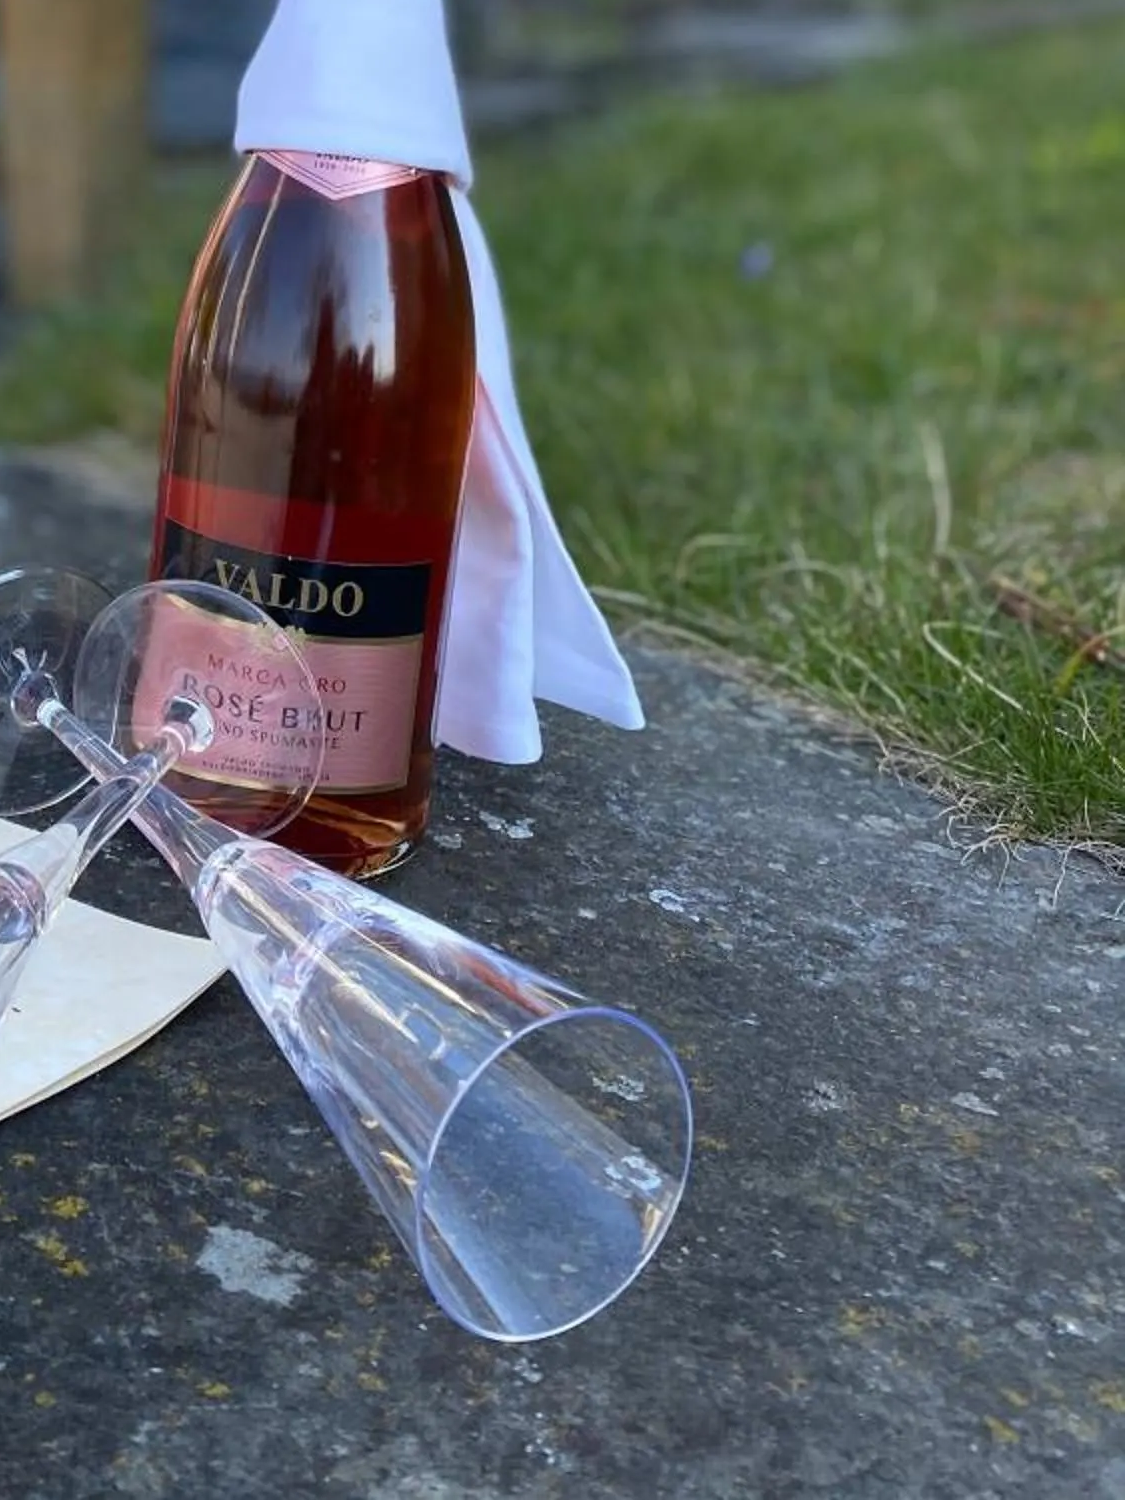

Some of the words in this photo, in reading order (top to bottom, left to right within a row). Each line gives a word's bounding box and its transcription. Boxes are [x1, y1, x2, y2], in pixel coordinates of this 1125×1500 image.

[216, 558, 364, 617] VALDO
[183, 672, 264, 723] ROSÉ
[281, 707, 368, 732] BRUT
[207, 653, 287, 690] MARCA
[299, 677, 346, 694] ORO
